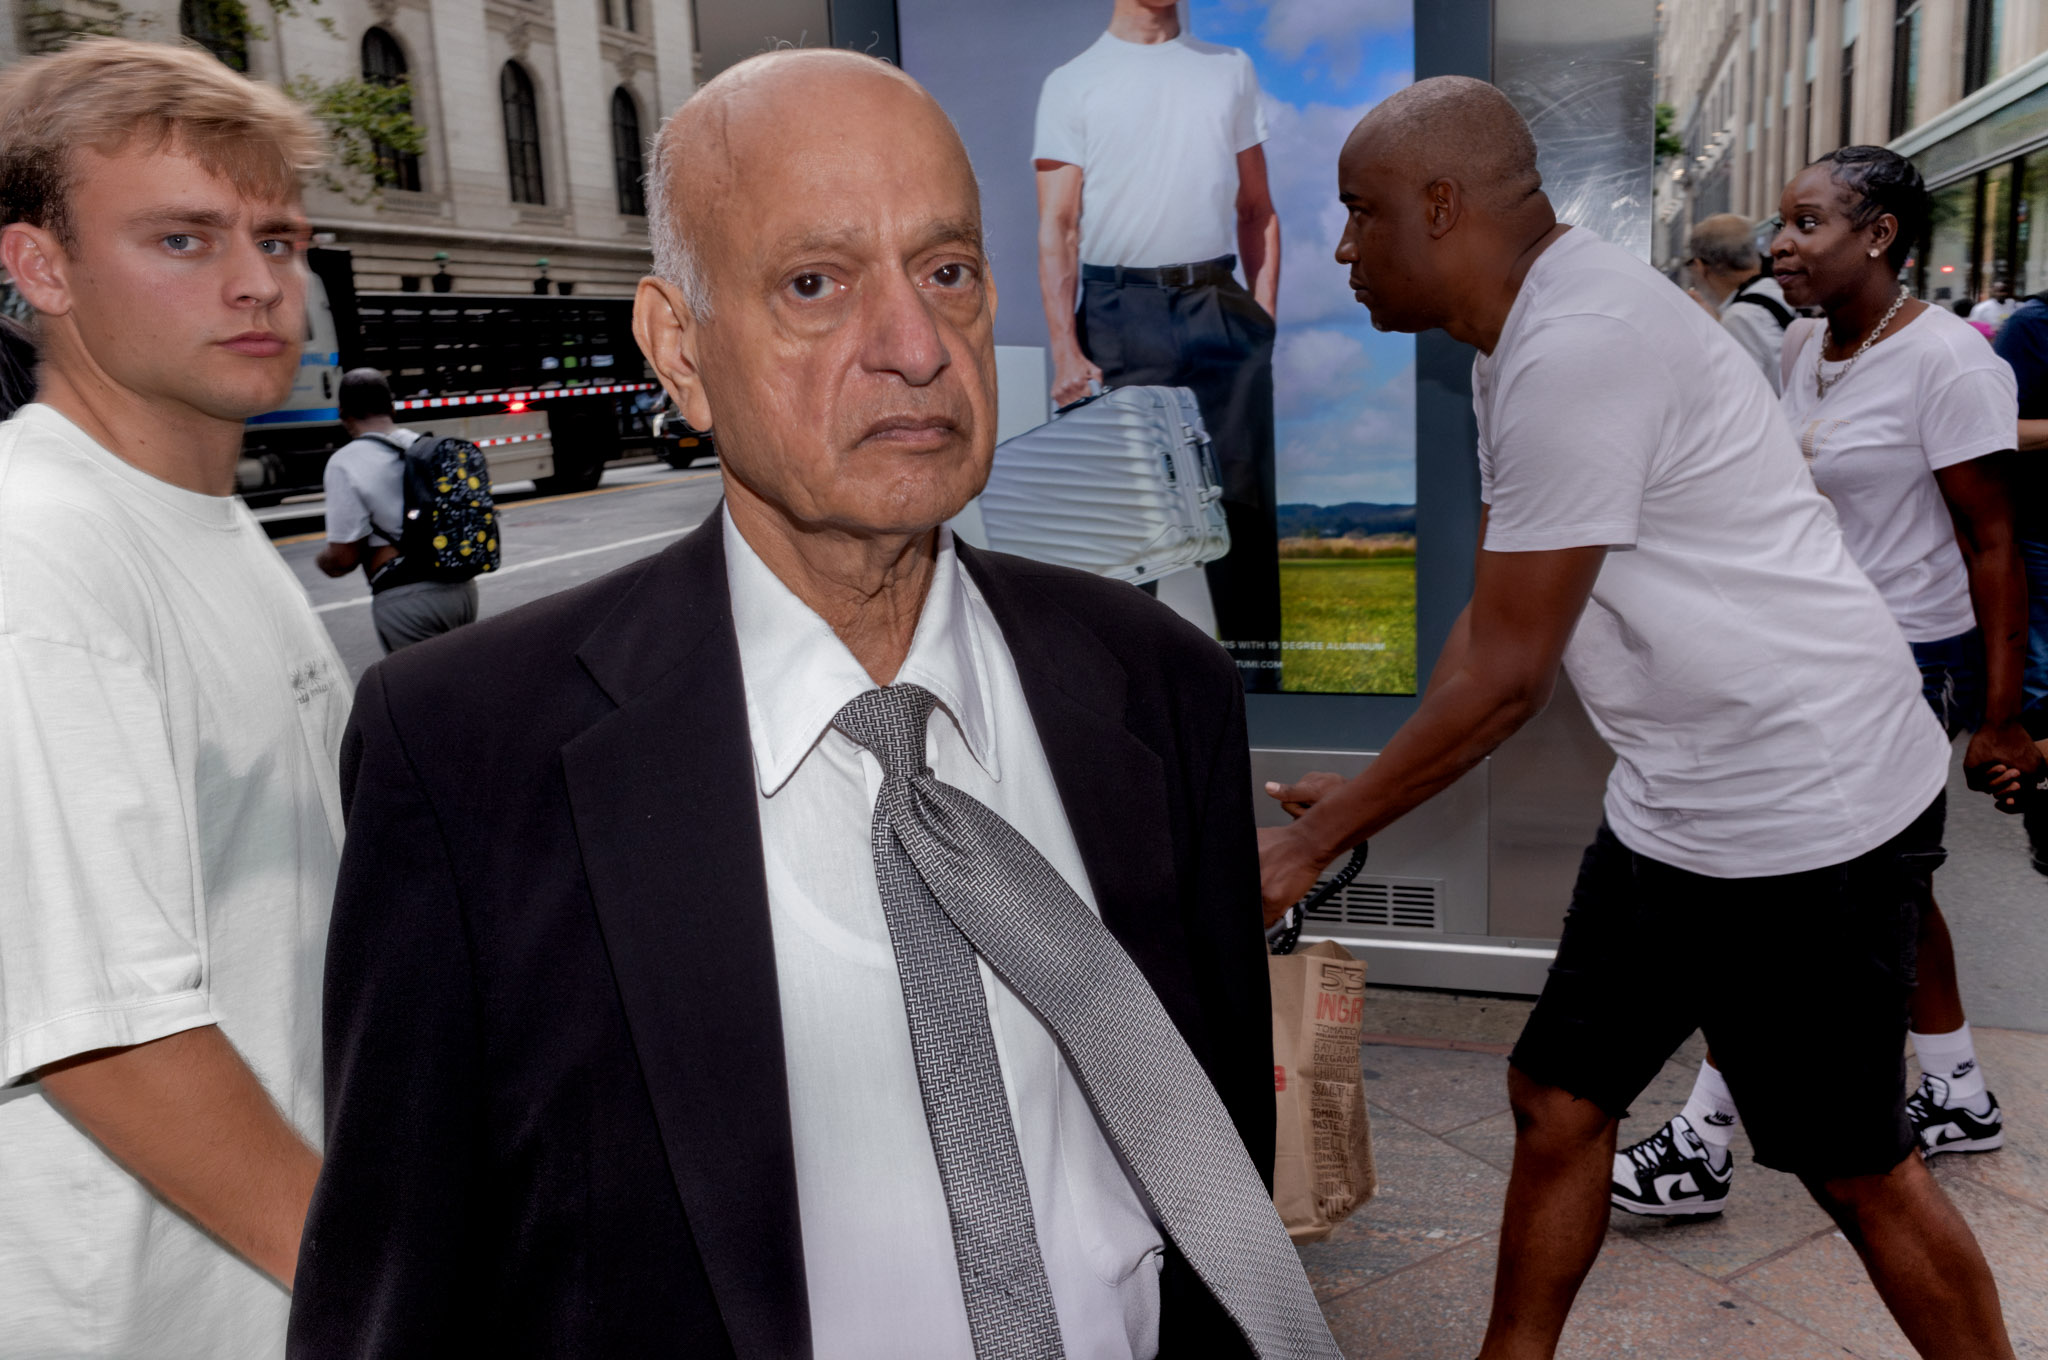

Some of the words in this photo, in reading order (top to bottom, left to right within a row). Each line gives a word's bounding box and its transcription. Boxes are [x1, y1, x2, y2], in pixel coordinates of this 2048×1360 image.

[1238, 641, 1265, 650] WITH
[1267, 641, 1279, 650] 19
[1282, 641, 1324, 650] DEGREE
[1326, 642, 1386, 650] ALUMINUM
[1236, 660, 1284, 669] TUMI.COM
[1321, 963, 1364, 994] 53
[1314, 1023, 1358, 1036] TOMATO
[1314, 1041, 1331, 1054] BAY
[1313, 1053, 1356, 1064] OREGANO
[1957, 1059, 1974, 1070] NIKE
[1311, 1081, 1346, 1098] SALT
[1310, 1107, 1344, 1121] TOMATO
[1712, 1110, 1735, 1122] NIKE
[1312, 1119, 1340, 1131] PASTE
